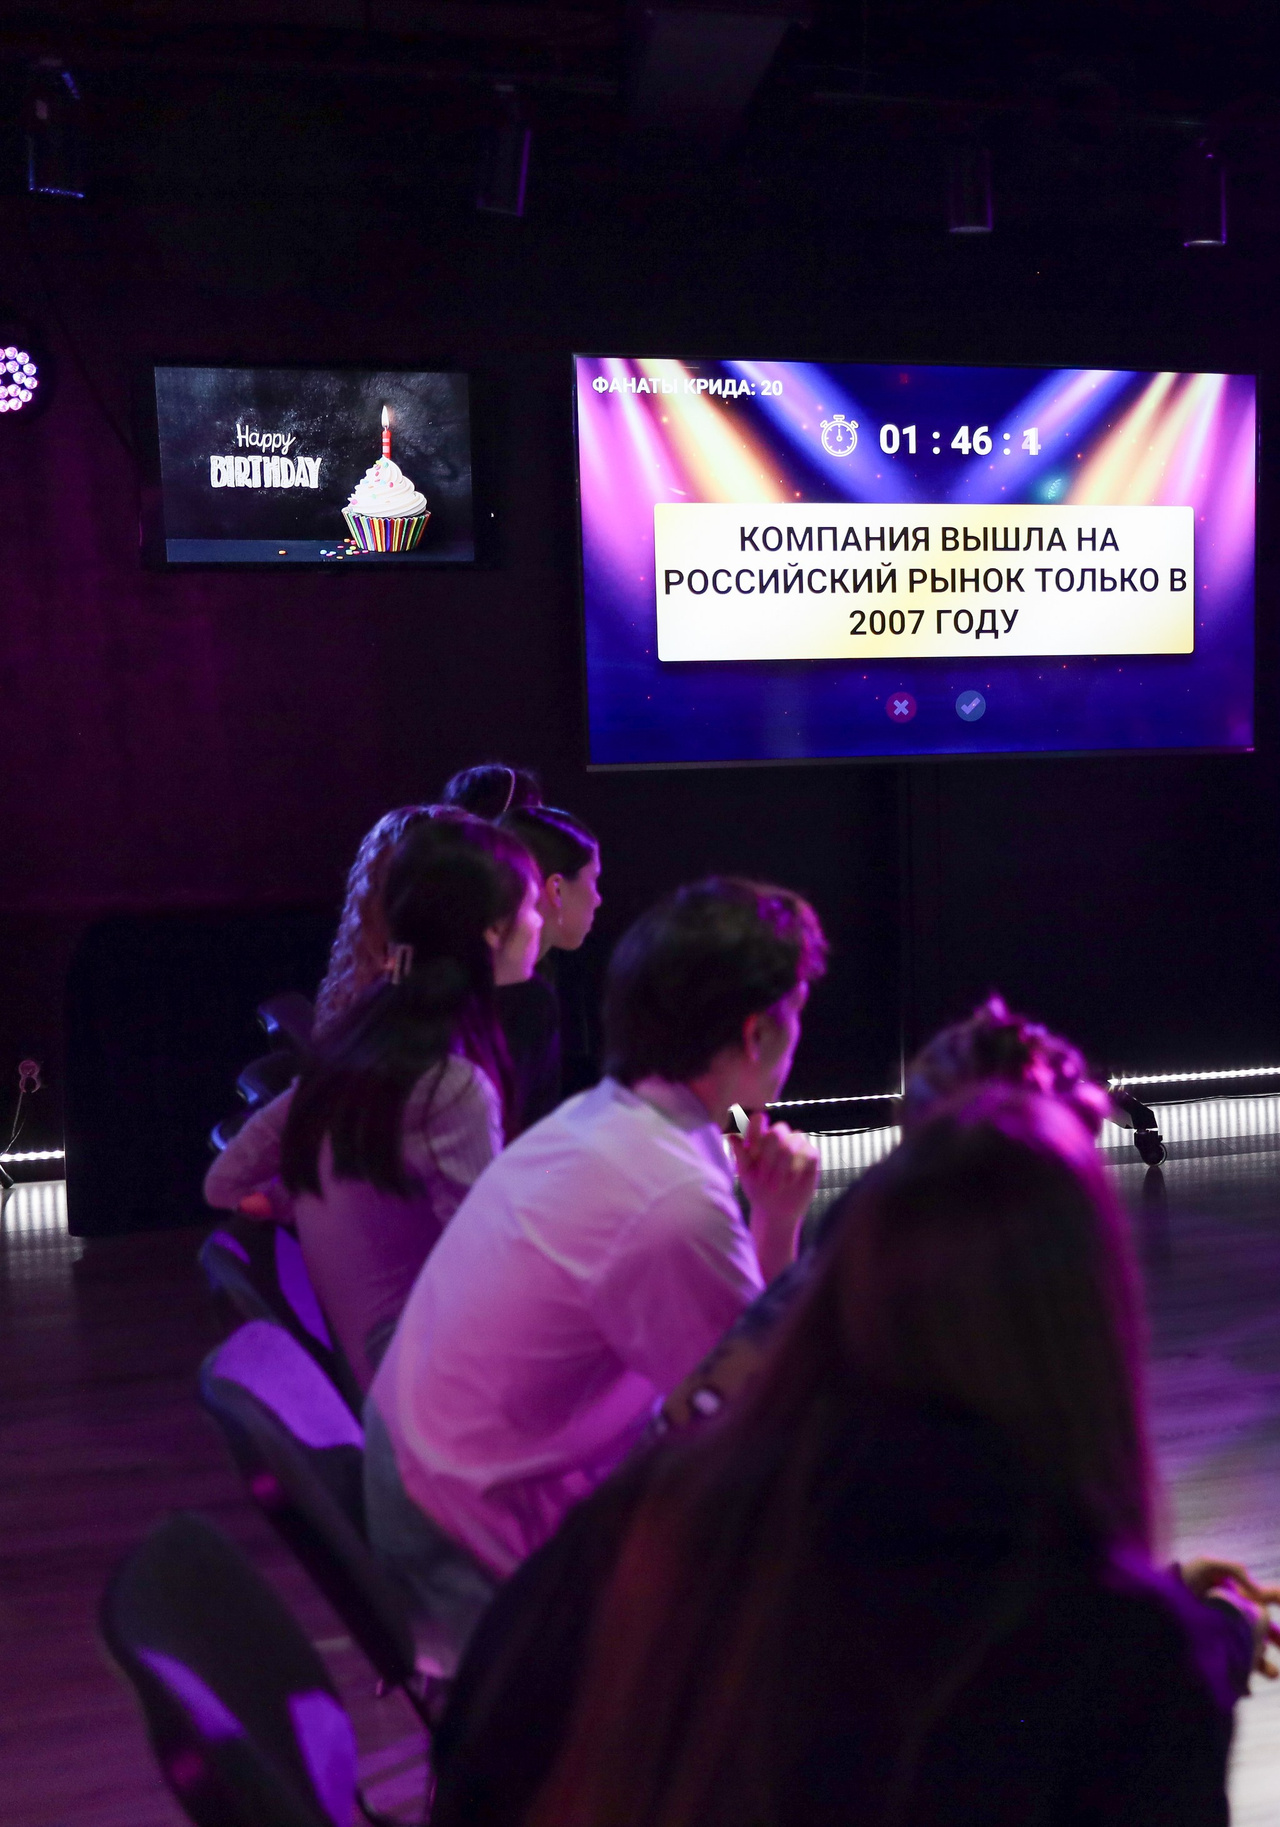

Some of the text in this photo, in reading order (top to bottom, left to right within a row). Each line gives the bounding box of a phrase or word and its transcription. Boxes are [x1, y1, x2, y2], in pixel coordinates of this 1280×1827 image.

[592, 376, 783, 398] ФАНАТЫ КРИДА: 20
[236, 423, 296, 455] Happy
[879, 423, 917, 455] 01
[950, 425, 993, 456] 46
[210, 455, 322, 489] BIRTHDAY
[739, 525, 1120, 552] КОМПАНИЯ ВЫШЛА НА
[664, 562, 1187, 595] РОССИЙСКИЙ РЫНОК ТОЛЬКО В
[849, 608, 1020, 640] 2007 ГОДУ
